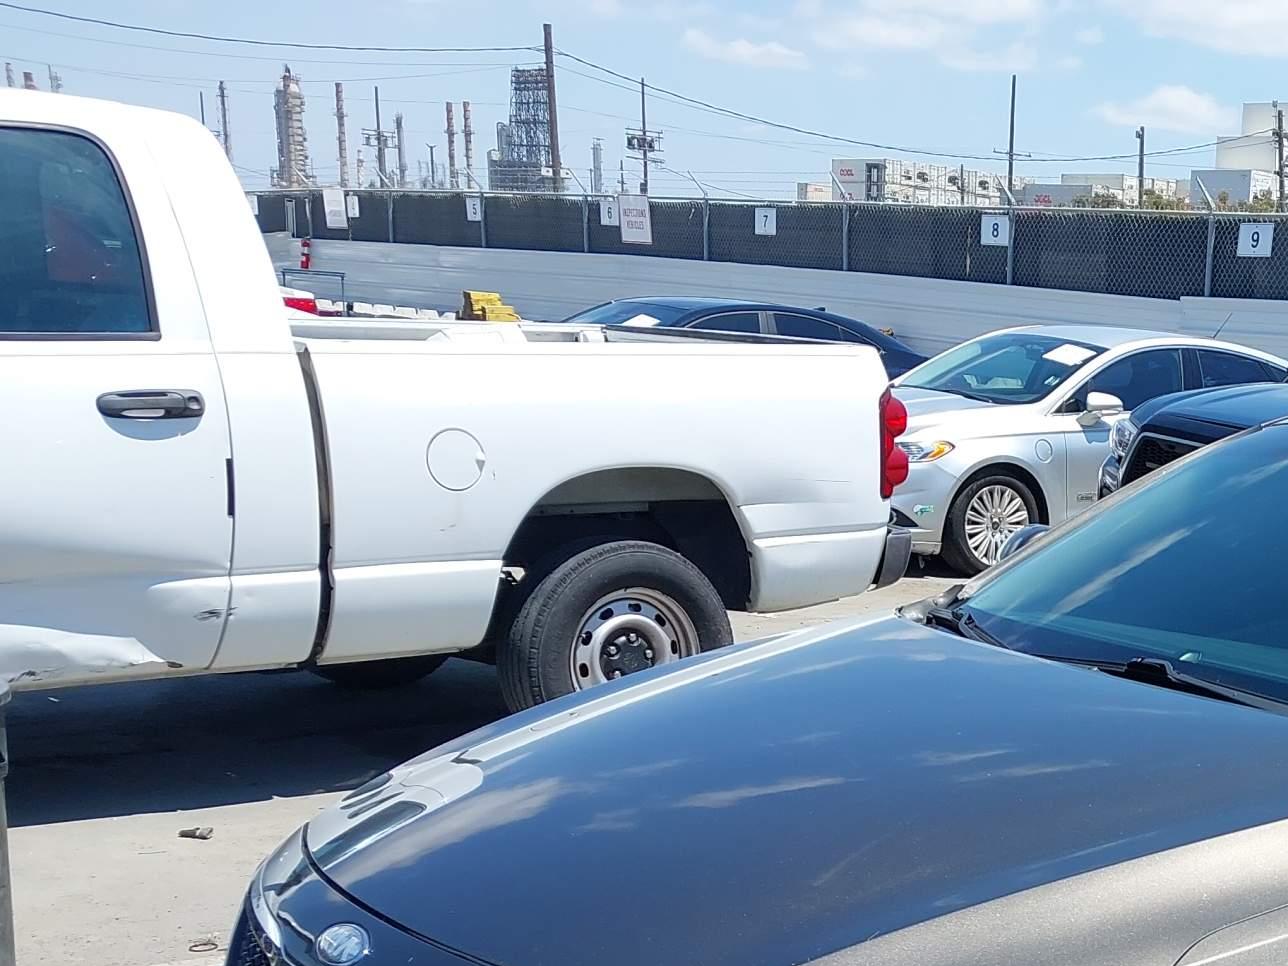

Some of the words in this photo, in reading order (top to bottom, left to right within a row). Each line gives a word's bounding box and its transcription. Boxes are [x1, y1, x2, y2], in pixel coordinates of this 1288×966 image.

[607, 206, 613, 219] 6
[762, 214, 769, 228] 7
[991, 222, 999, 238] 8
[1251, 231, 1260, 248] 9
